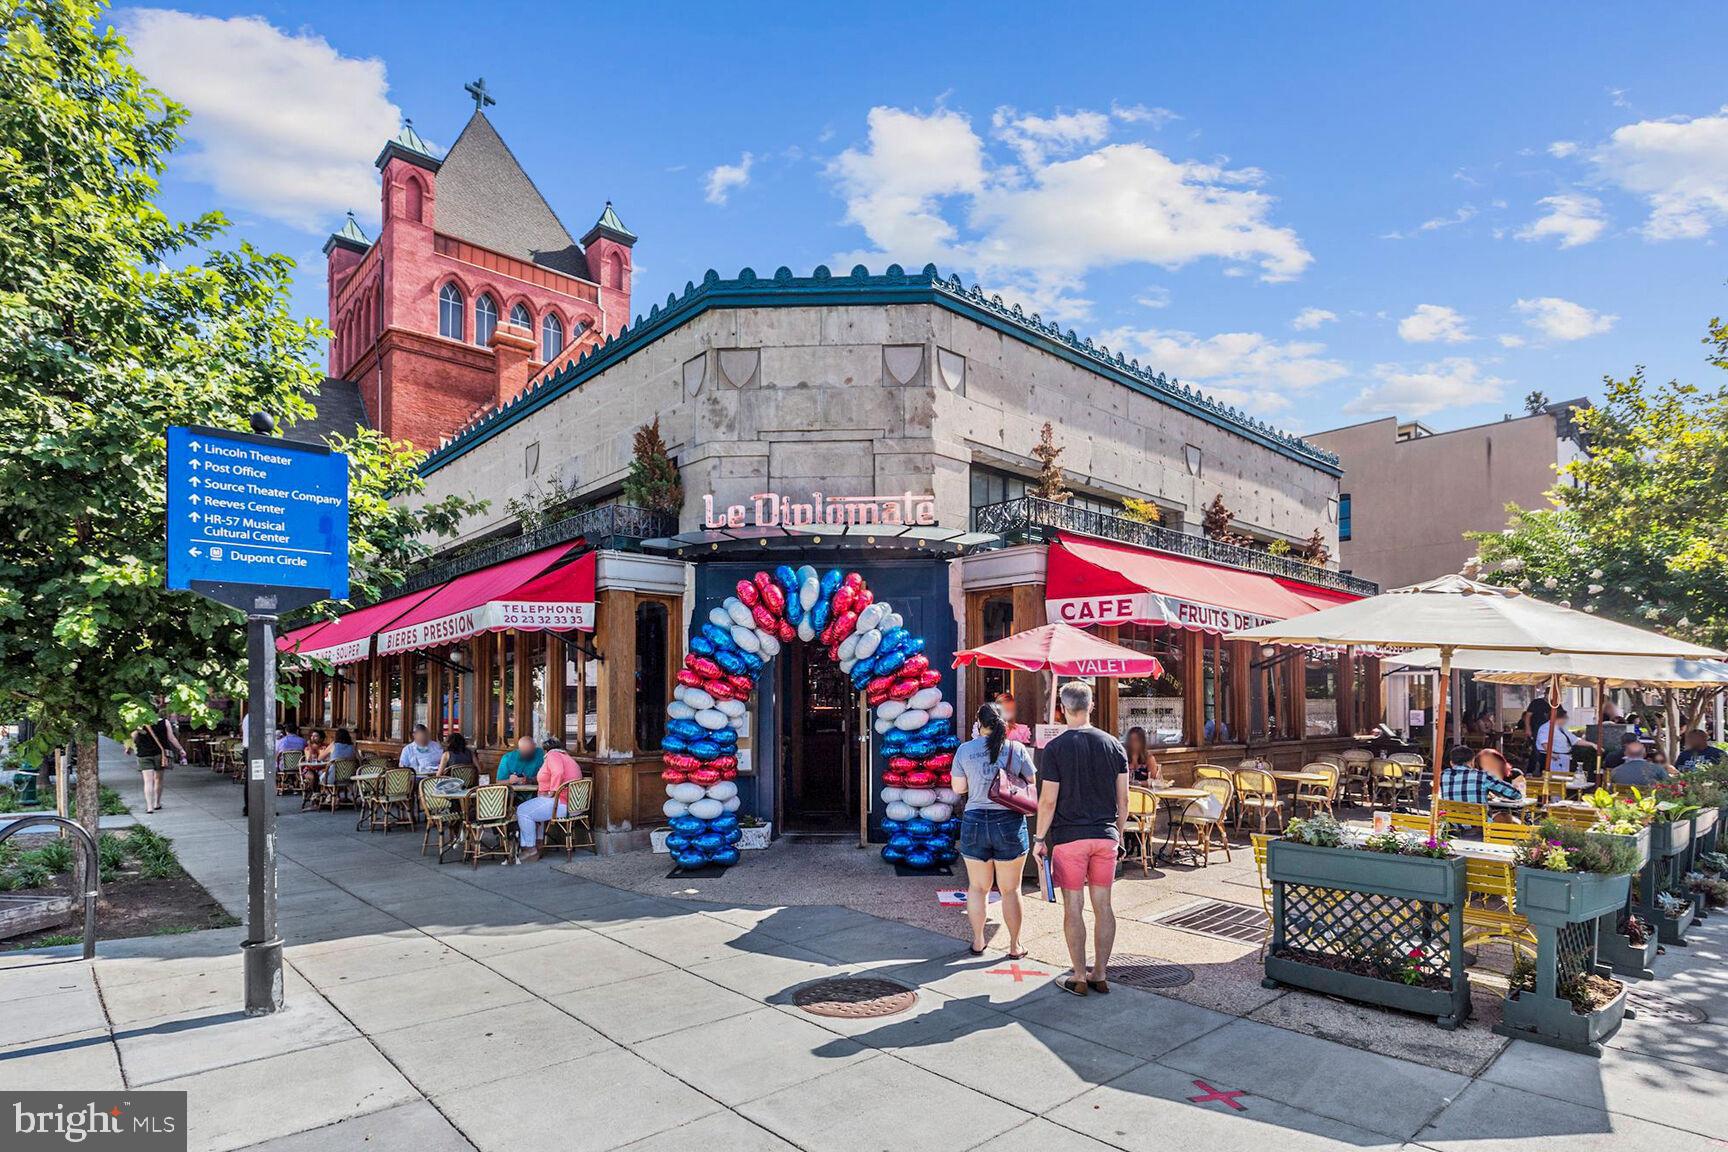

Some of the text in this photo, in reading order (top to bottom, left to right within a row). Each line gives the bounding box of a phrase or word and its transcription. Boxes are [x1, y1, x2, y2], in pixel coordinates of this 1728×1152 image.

[204, 443, 293, 466] Lincoln Theater
[204, 461, 267, 479] Post Office
[204, 478, 342, 507] Source Theater Company
[204, 496, 286, 515] Reeves Center
[703, 491, 935, 528] Le Diplomate
[204, 514, 285, 531] HR-57 Musical
[204, 526, 290, 544] Cultural Center
[230, 551, 308, 567] Dupont Circle
[502, 604, 582, 614] TELEPHONE
[1060, 599, 1133, 620] CAFE
[1179, 604, 1229, 628] FRUITS
[1233, 613, 1250, 630] DE
[504, 615, 584, 624] 20 23 32 33 33
[387, 613, 475, 649] BIERES PRESSION
[1076, 659, 1127, 673] VALET
